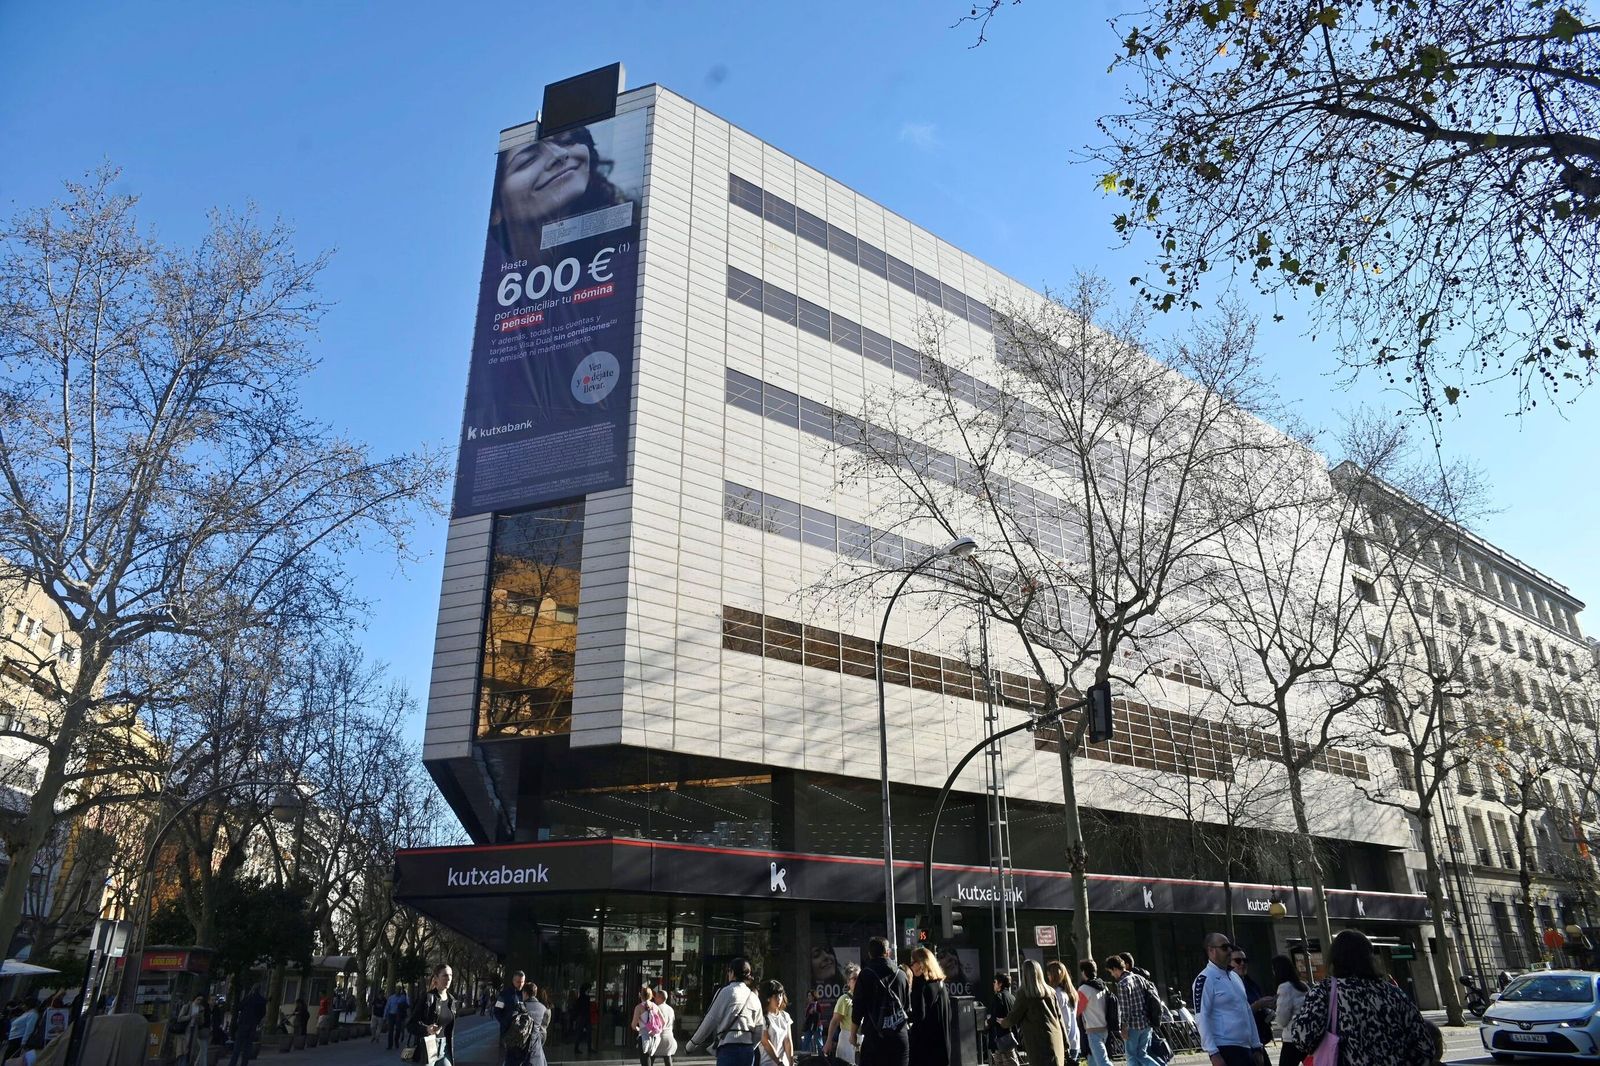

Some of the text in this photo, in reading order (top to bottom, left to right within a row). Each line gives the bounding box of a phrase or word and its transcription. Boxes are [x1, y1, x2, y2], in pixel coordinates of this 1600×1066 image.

[497, 243, 630, 306] 600 € (1)
[501, 259, 527, 272] Hasta
[494, 285, 613, 322] por domiciliar tu nómina
[498, 333, 528, 346] además,
[530, 328, 551, 338] todas
[565, 318, 594, 330] cuentas
[594, 314, 601, 322] y
[501, 313, 545, 331] pensión.
[488, 357, 498, 365] de
[499, 350, 527, 363] emisión
[537, 335, 593, 355] mantenimiento.
[489, 344, 518, 356] tarjetas
[519, 341, 534, 349] Visa
[535, 336, 553, 346] Dual
[554, 334, 566, 342] sin
[588, 363, 602, 372] Ven
[583, 382, 605, 394] llevar.
[480, 420, 533, 438] kutxabank
[447, 863, 549, 886] kutxabank
[816, 983, 841, 998] 600
